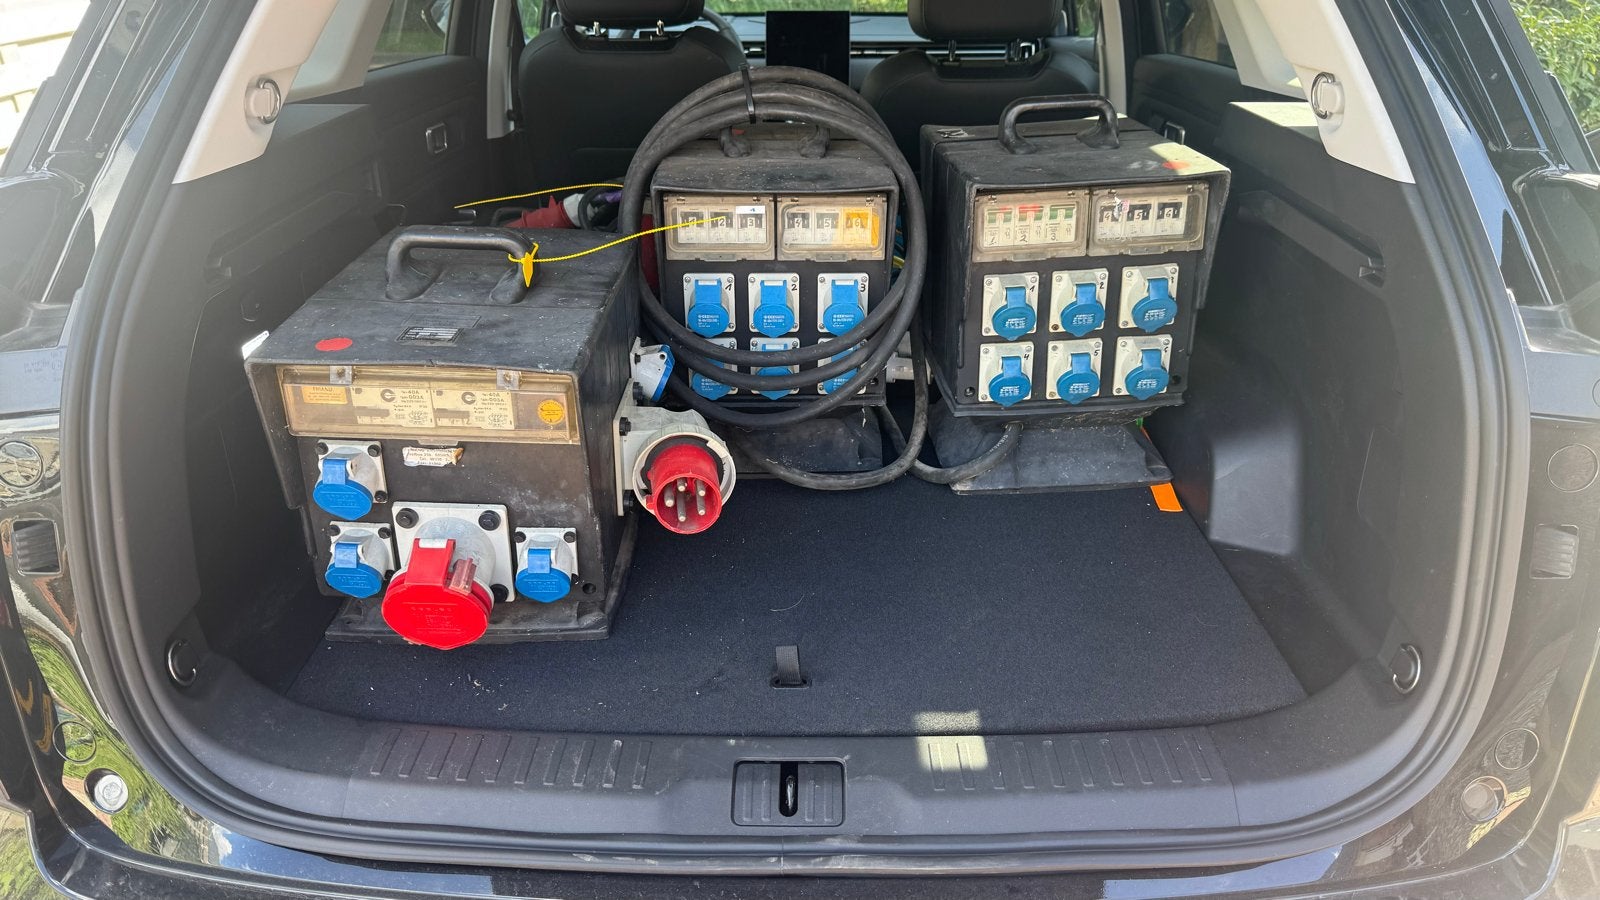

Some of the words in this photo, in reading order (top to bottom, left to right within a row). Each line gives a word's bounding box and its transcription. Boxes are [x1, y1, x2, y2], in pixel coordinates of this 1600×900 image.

[719, 218, 725, 227] 2
[825, 218, 831, 228] 5
[725, 283, 732, 291] 1
[791, 284, 798, 292] 2
[860, 283, 866, 292] 3
